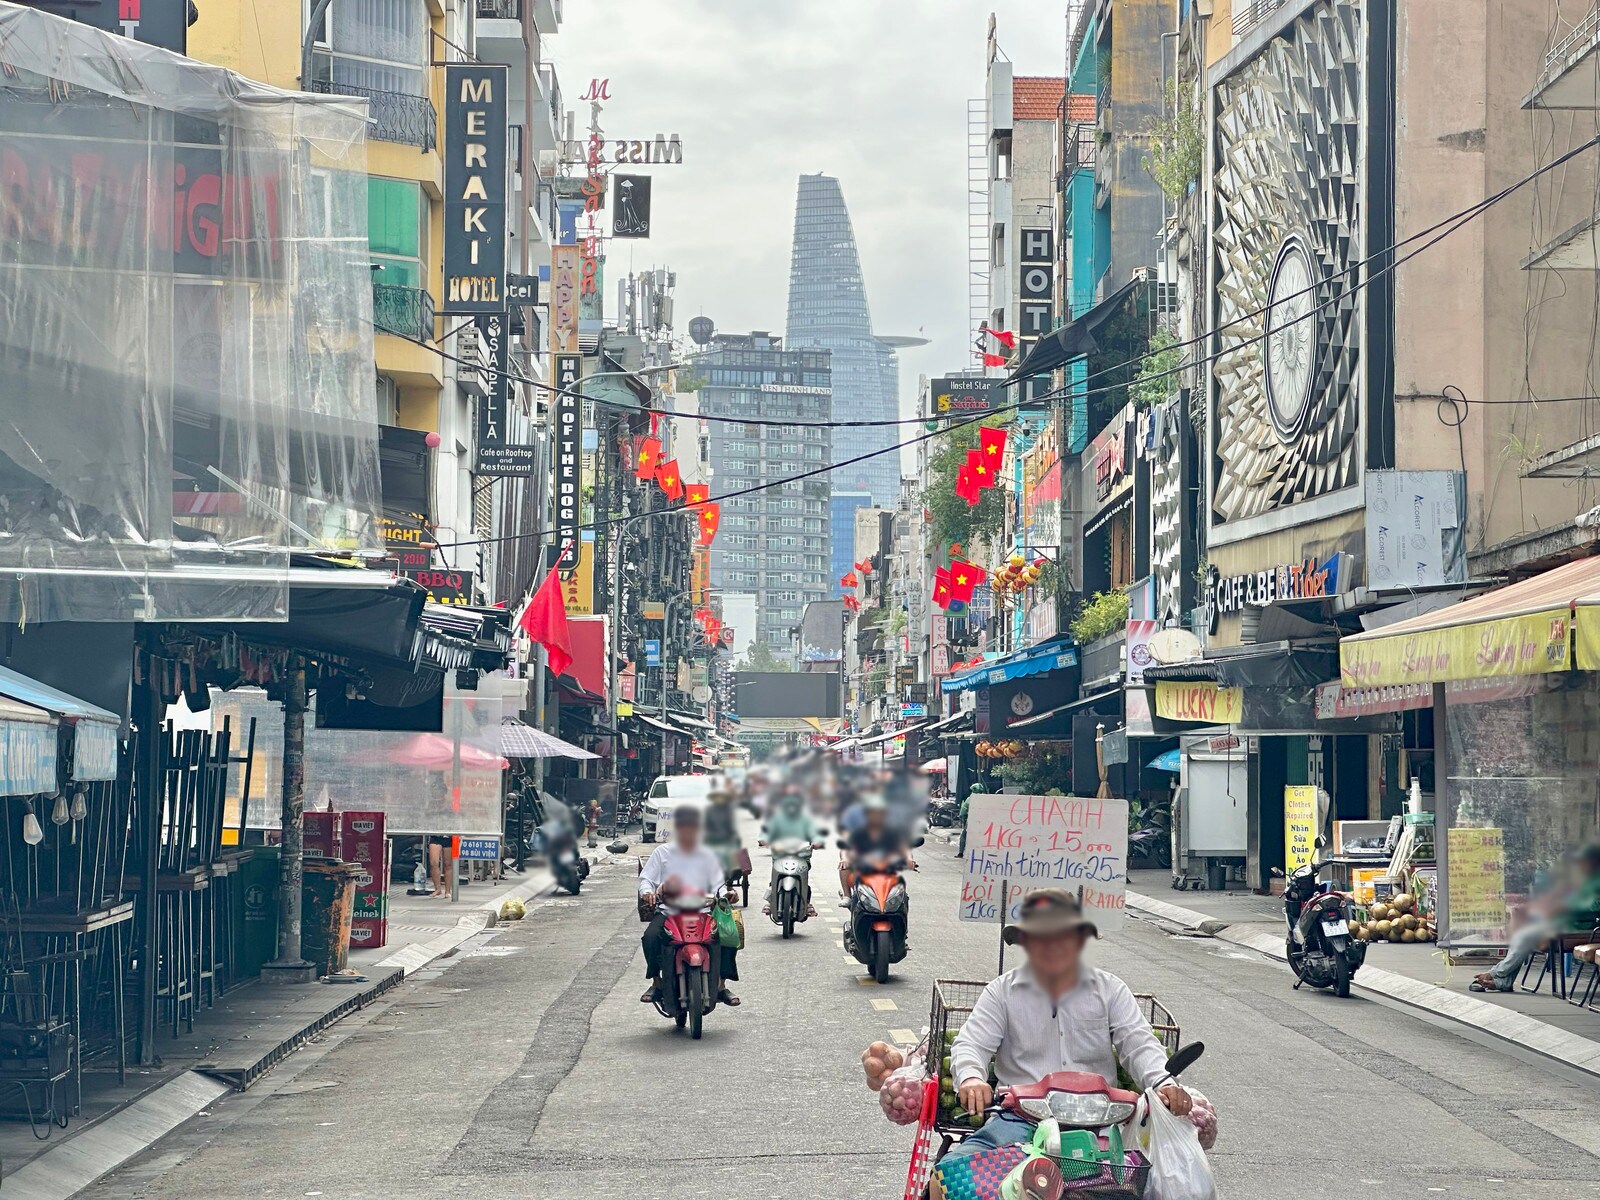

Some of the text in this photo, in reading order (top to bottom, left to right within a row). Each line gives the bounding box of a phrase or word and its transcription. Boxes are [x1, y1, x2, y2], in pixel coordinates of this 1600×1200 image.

[460, 78, 492, 264] MERAKI
[448, 275, 499, 302] HOTEL
[555, 252, 574, 351] HAPPY
[1025, 232, 1049, 405] HOTL
[562, 359, 575, 407] HAR
[950, 381, 991, 390] Hostel Star
[562, 413, 575, 435] OF
[480, 448, 496, 457] Cafe
[505, 448, 533, 458] Rooftop
[561, 441, 575, 477] THE
[480, 463, 532, 472] Restaurant
[560, 483, 574, 520] DOG
[403, 552, 426, 565] 2010
[416, 572, 463, 589] BBQ
[1291, 558, 1330, 599] Tiger
[1216, 573, 1244, 613] CAFE
[1175, 687, 1218, 720] LUCKY
[1288, 800, 1311, 808] Clothes
[1294, 789, 1305, 798] Get
[1286, 811, 1314, 821] Repaired
